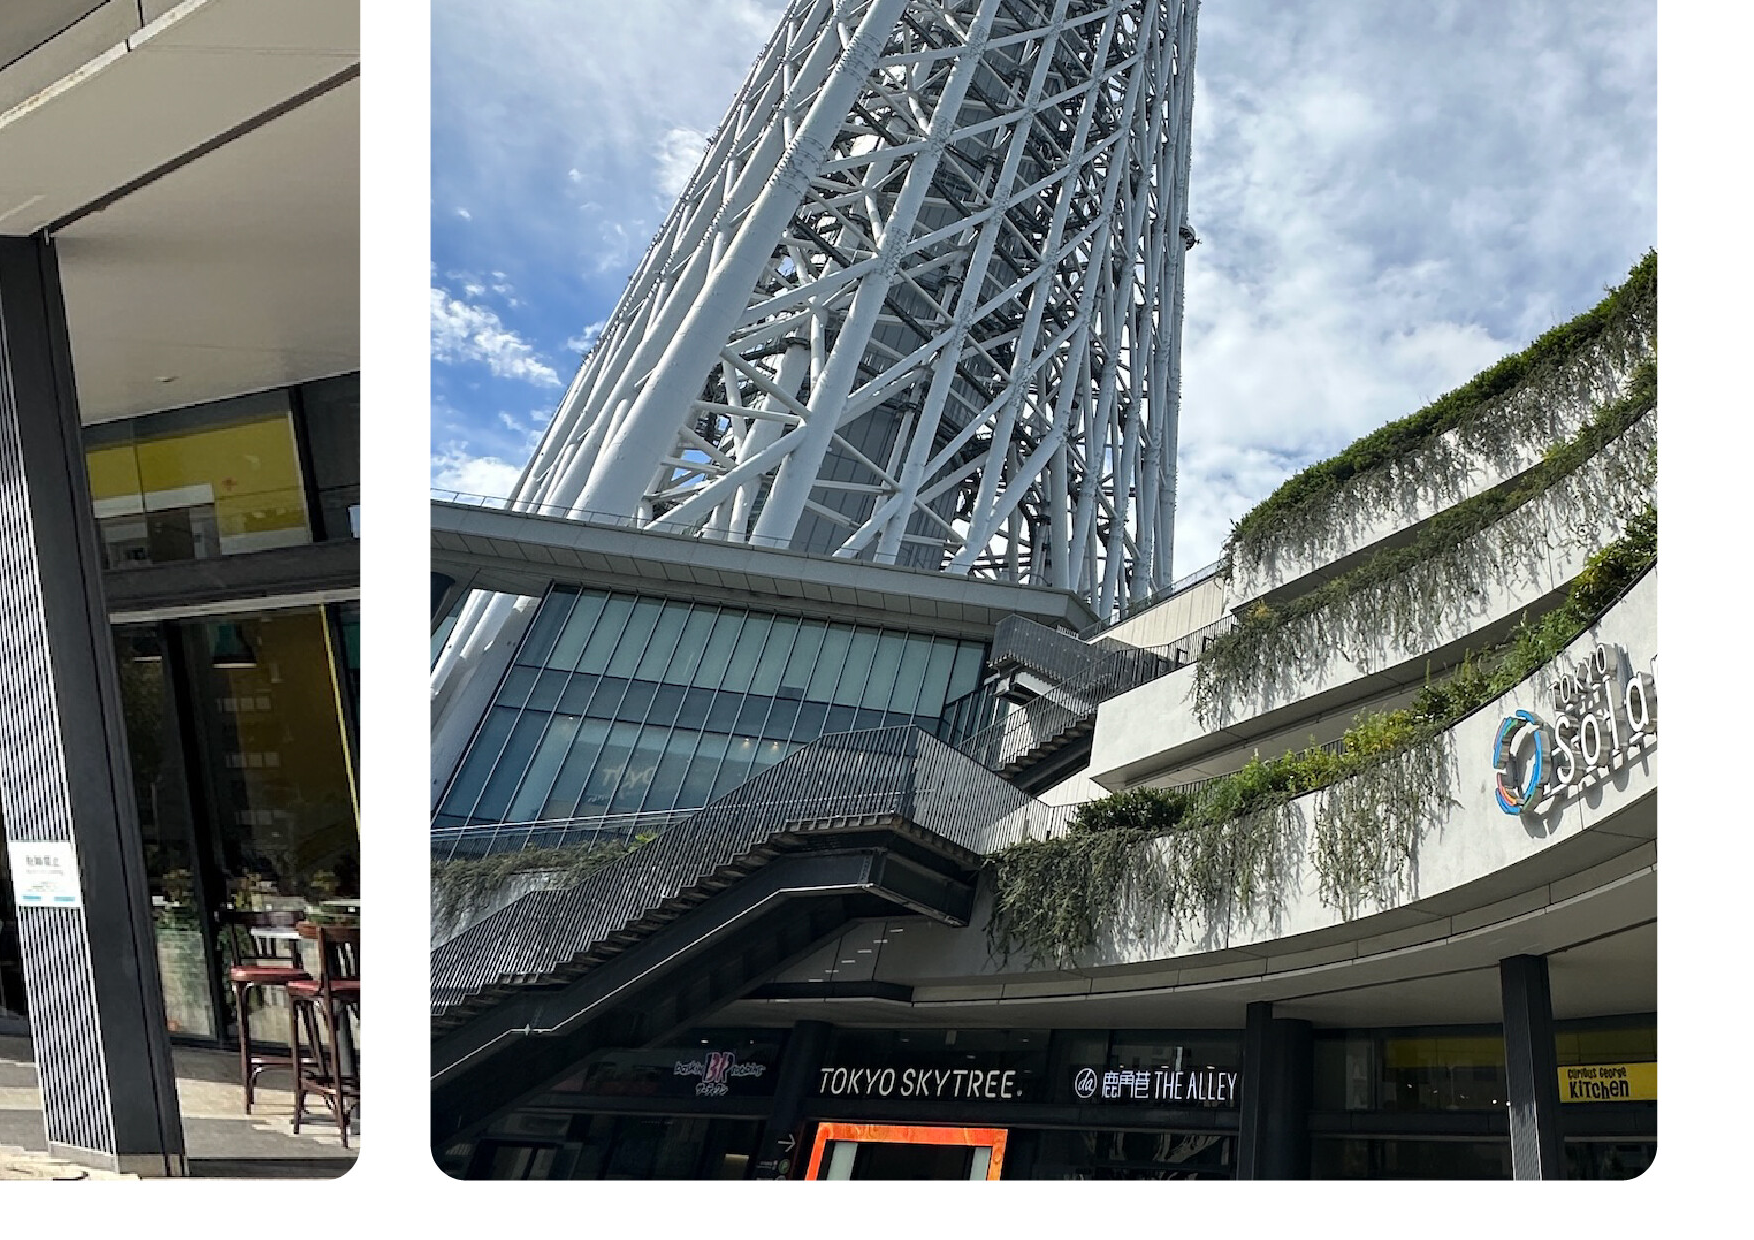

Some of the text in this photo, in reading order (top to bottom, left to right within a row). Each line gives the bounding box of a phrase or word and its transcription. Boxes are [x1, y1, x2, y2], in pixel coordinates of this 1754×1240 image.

[1555, 658, 1657, 784] Sola
[820, 1067, 895, 1096] TOKYO
[1154, 1070, 1238, 1100] THE ALLEY
